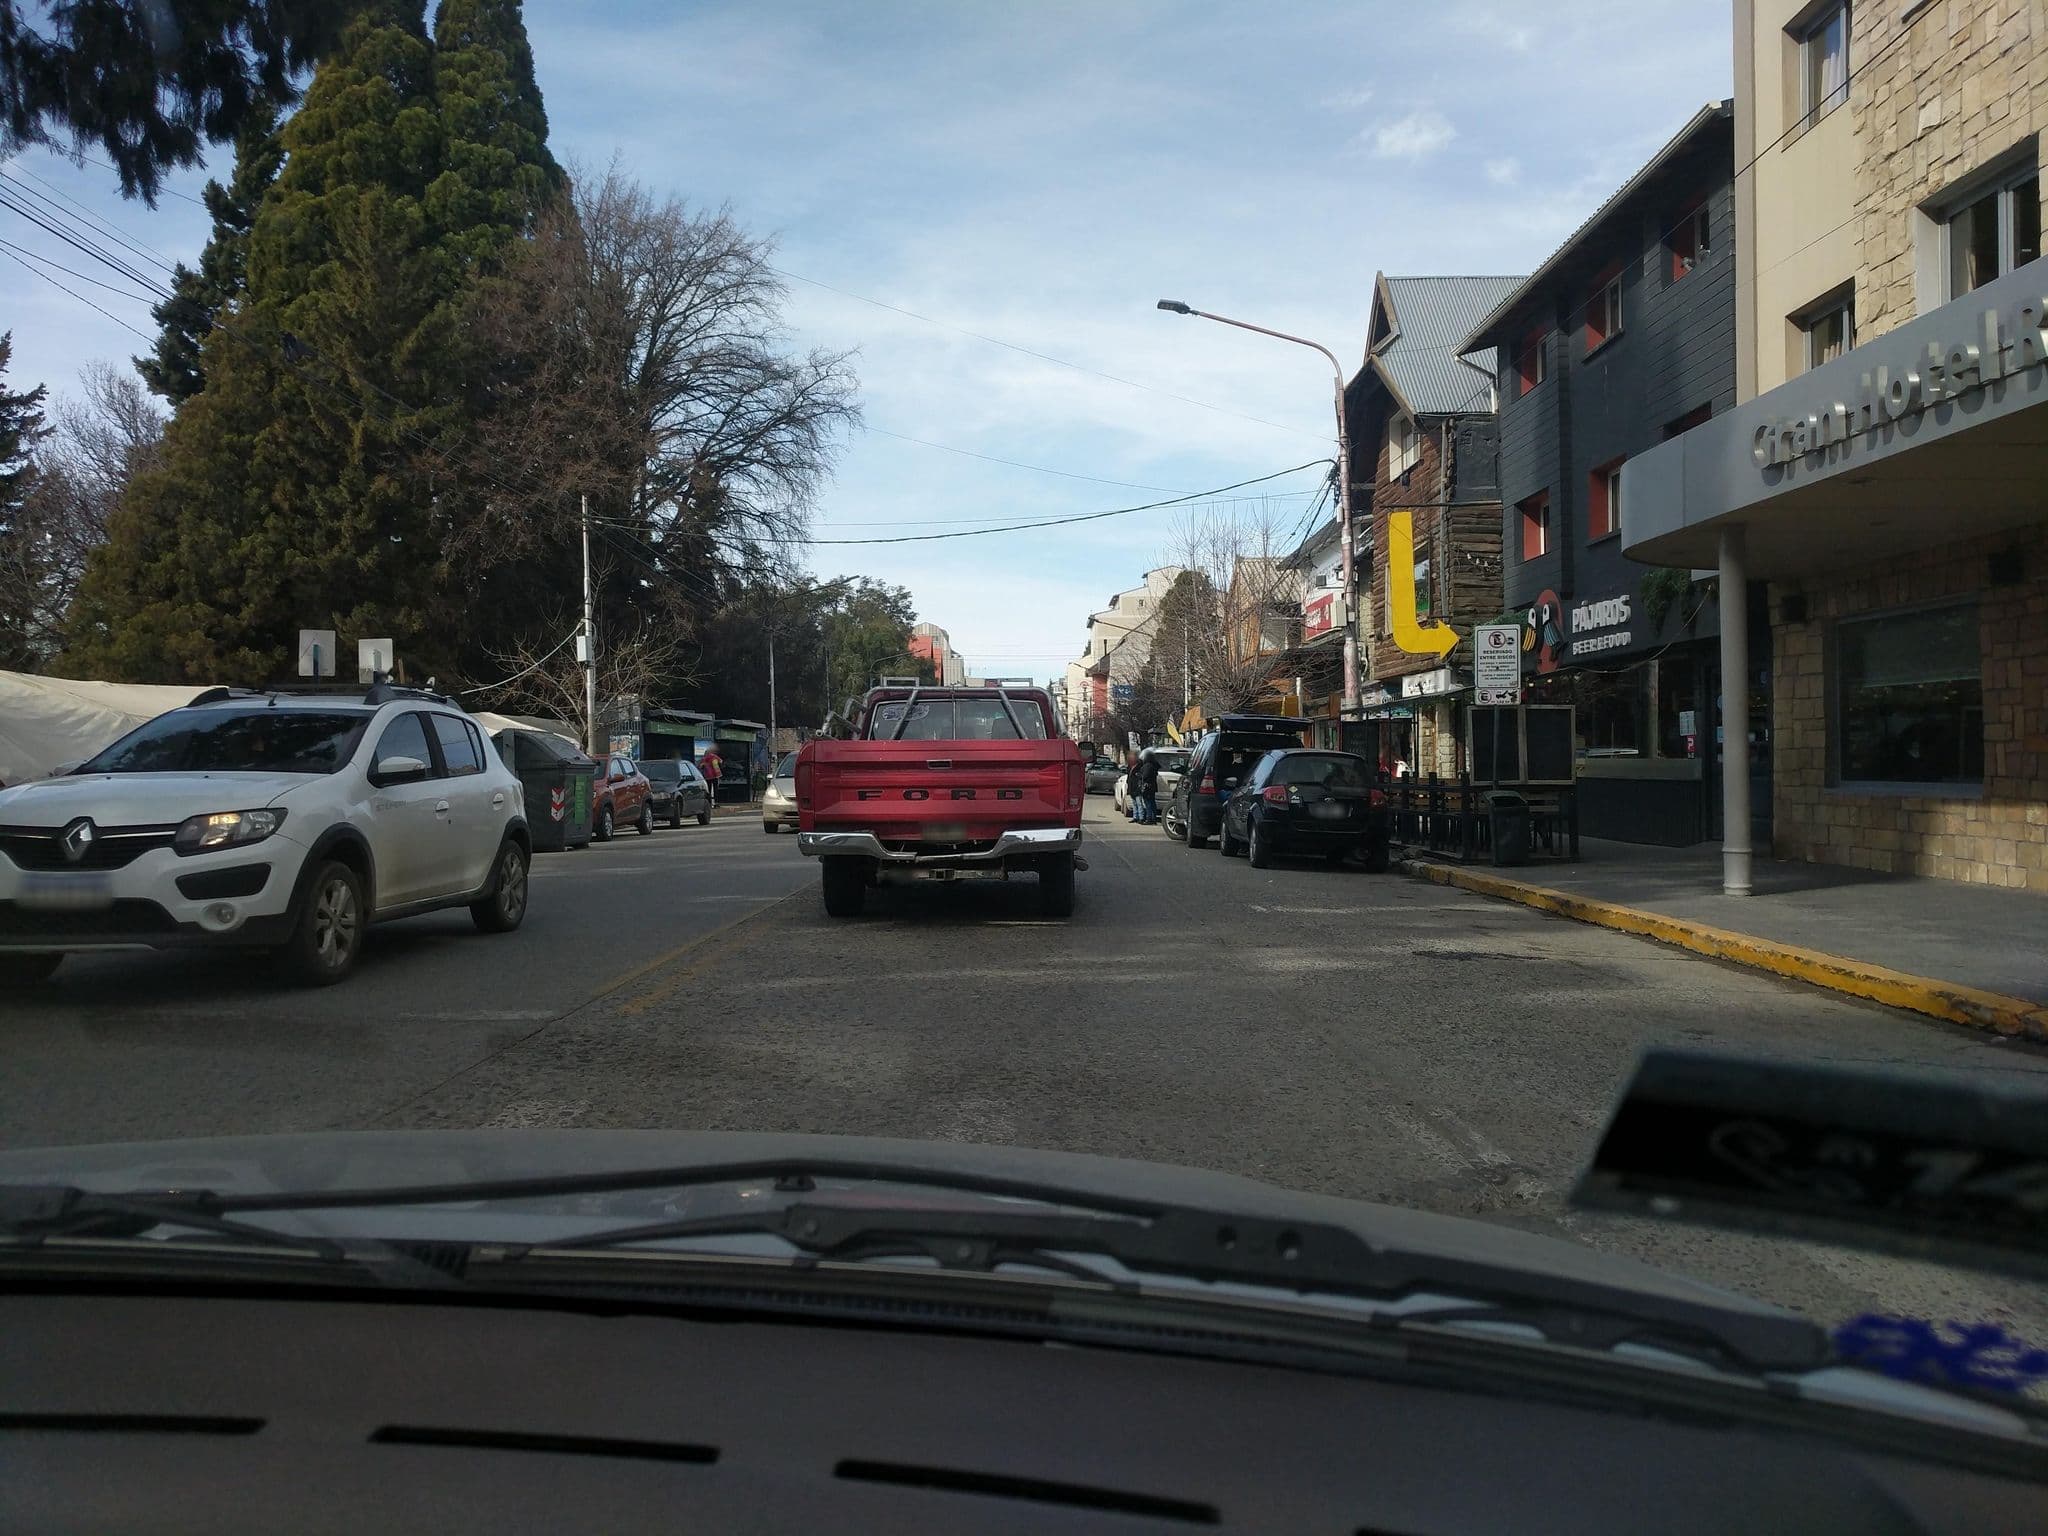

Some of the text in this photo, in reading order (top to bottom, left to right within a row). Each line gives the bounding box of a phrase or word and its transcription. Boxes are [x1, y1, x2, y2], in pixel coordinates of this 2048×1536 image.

[1751, 402, 1847, 469] Gran
[1853, 309, 2001, 432] Hotel
[1572, 594, 1631, 634] PÁJAROS
[857, 789, 1024, 801] FORD
